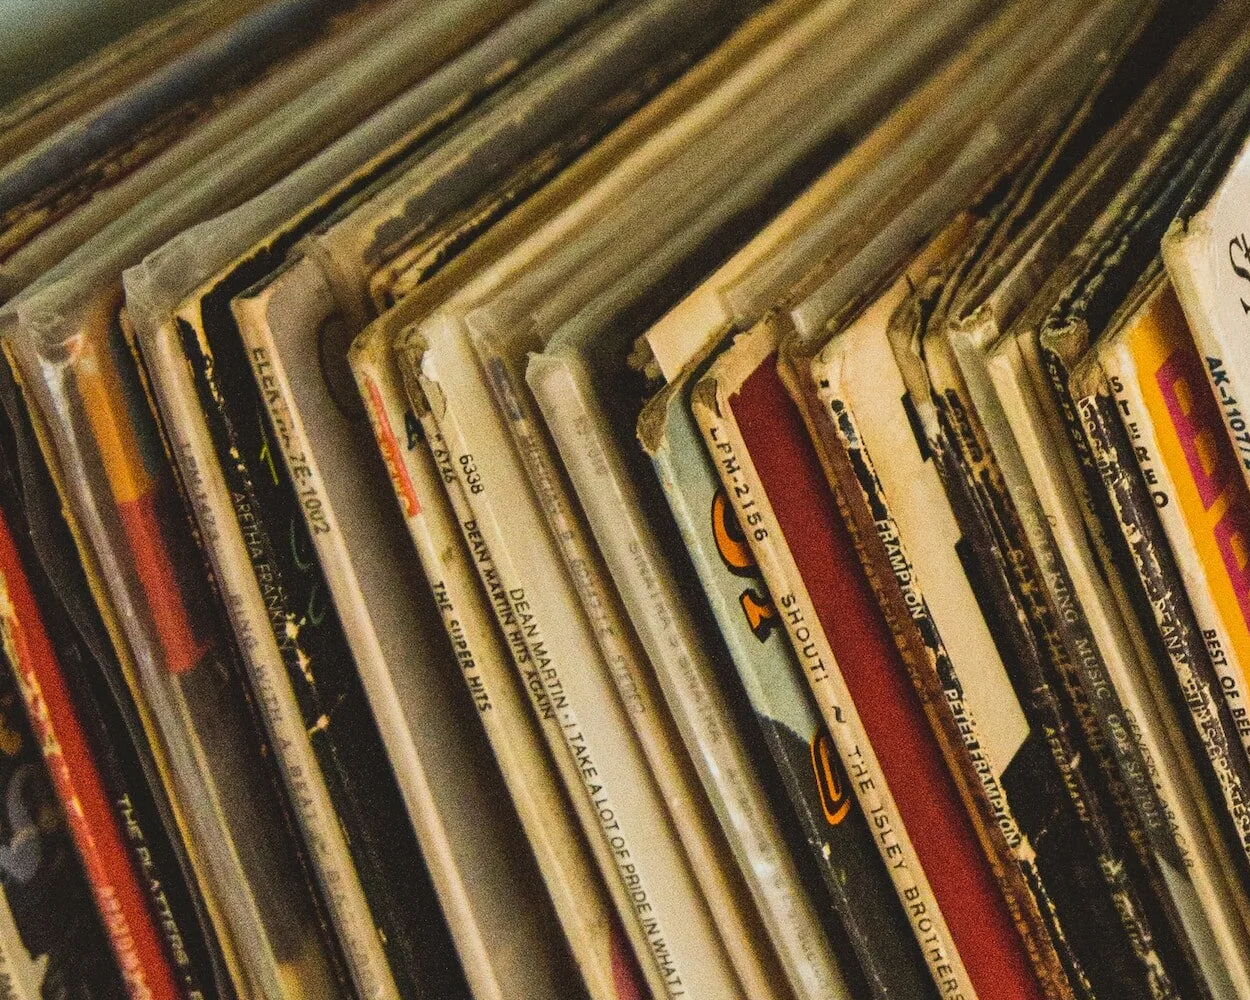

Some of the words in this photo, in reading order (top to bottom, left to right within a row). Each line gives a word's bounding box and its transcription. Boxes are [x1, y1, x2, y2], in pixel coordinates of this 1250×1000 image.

[455, 451, 487, 497] 6338
[228, 489, 268, 560] ARETHA
[248, 560, 301, 654] FRANKLIN
[1105, 372, 1171, 510] STEREO
[1201, 627, 1229, 670] BEST
[1218, 673, 1241, 702] OF
[431, 579, 454, 614] THE
[445, 617, 476, 672] SUPER
[466, 673, 493, 714] HITS
[462, 518, 491, 564] DEAN
[481, 566, 517, 627] MARTIN
[507, 629, 533, 665] HITS
[523, 667, 556, 722] AGAIN
[507, 585, 541, 640] DEAN
[528, 637, 571, 711] MARTIN
[871, 515, 928, 622] FRAMPTON
[942, 685, 978, 747] PETER
[967, 745, 1020, 846] FRAMPTON
[1046, 569, 1079, 625] KING
[1074, 636, 1111, 702] MUSIC
[1104, 711, 1132, 757] ODE
[706, 422, 770, 544] LPM-2156
[778, 590, 830, 684] SHOUT!
[842, 744, 876, 795] THE
[867, 805, 909, 872] ISLEY
[901, 884, 967, 1000] BROTHERS
[566, 731, 598, 780] TAKE
[586, 779, 605, 797] A
[1040, 723, 1094, 824] AFTERMATH
[1119, 706, 1161, 780] GENESIS
[1156, 798, 1198, 871] ABACAB
[592, 795, 621, 835] LOT
[608, 833, 632, 863] OF
[113, 792, 145, 844] THE
[131, 843, 191, 968] PLATTERS
[619, 859, 654, 916] PRIDE
[641, 914, 663, 937] IN
[650, 935, 684, 989] WHAT
